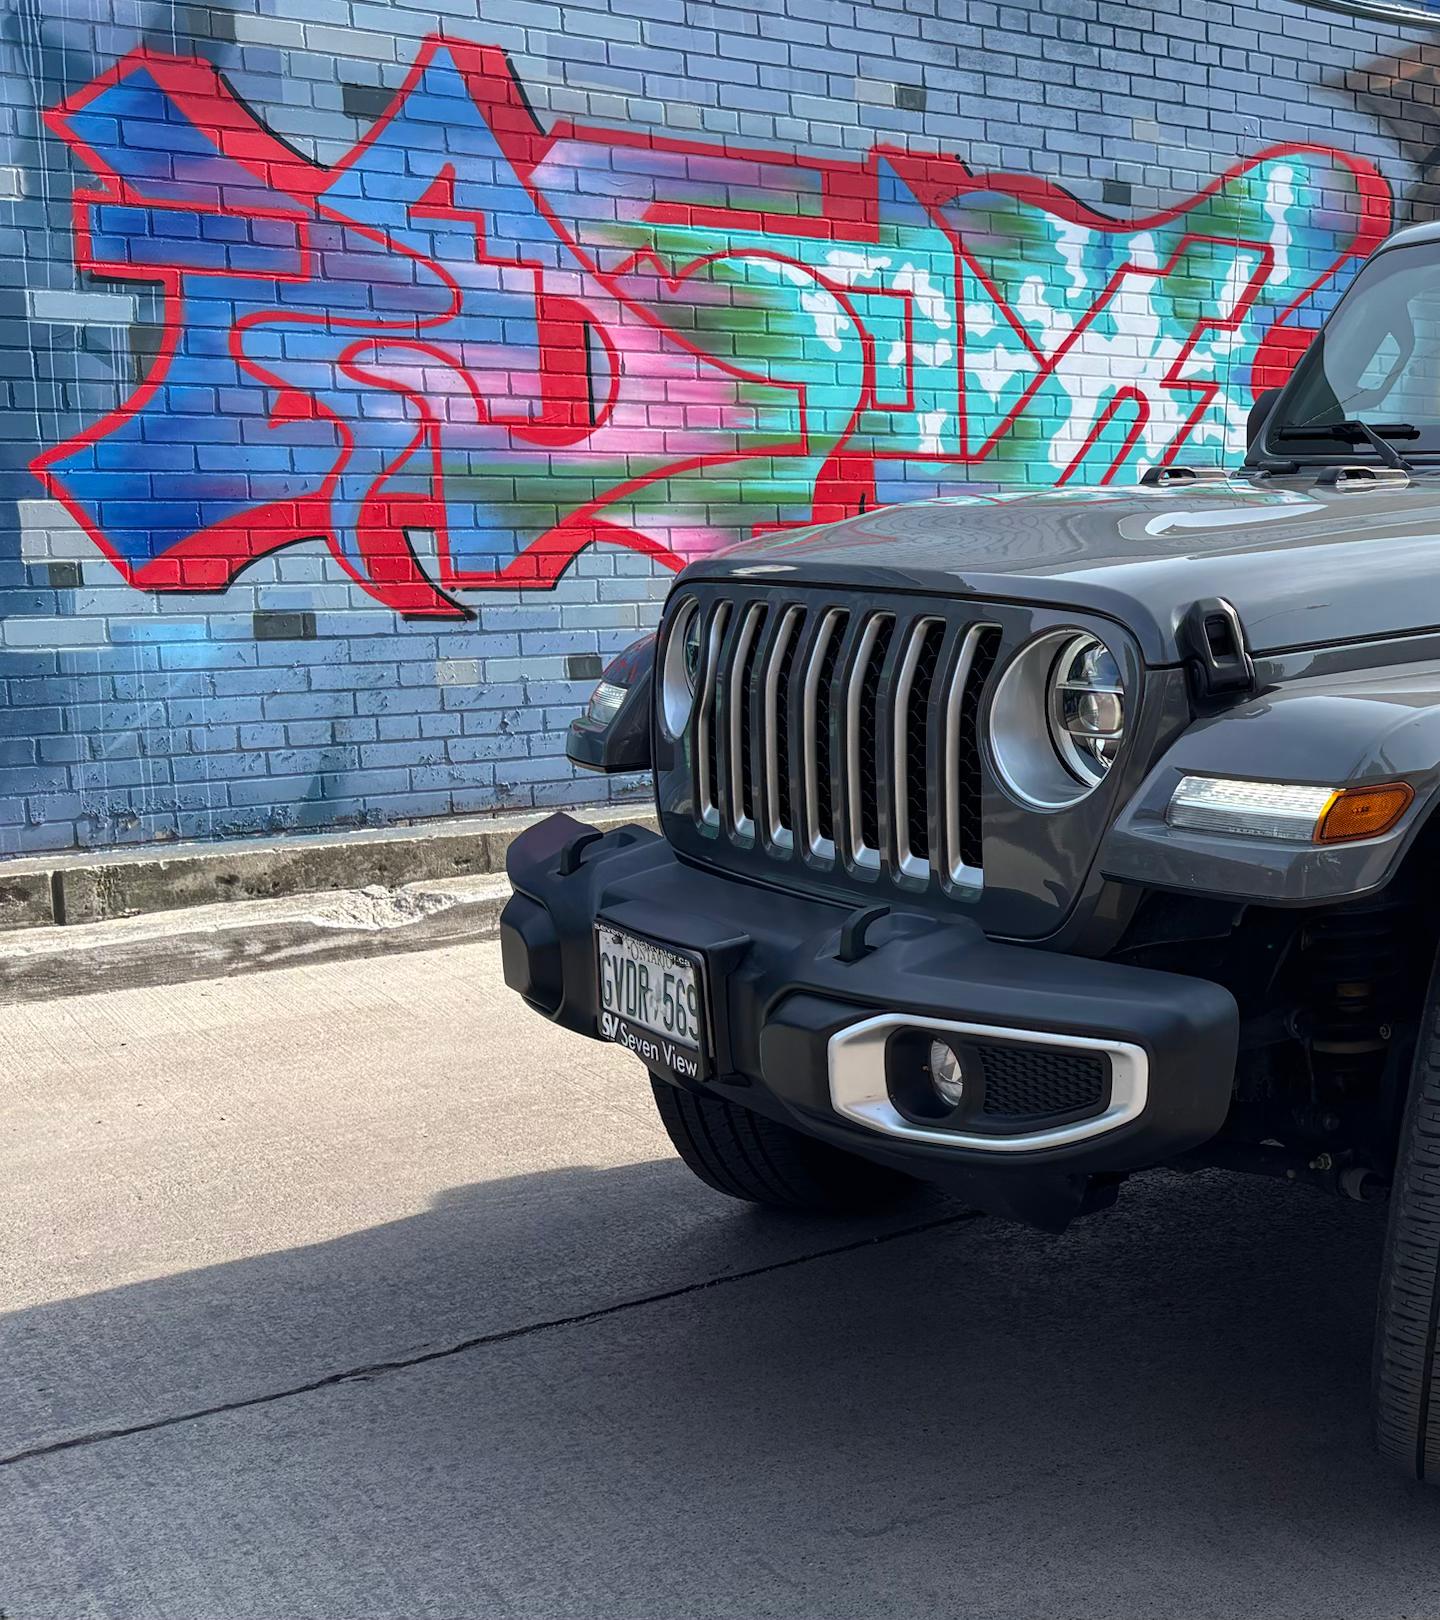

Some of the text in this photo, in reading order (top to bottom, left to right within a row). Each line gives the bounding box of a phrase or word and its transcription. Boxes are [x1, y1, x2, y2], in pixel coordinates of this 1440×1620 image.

[601, 952, 699, 1041] GVDR 569
[620, 1022, 659, 1062] Seven
[662, 1040, 698, 1077] View
